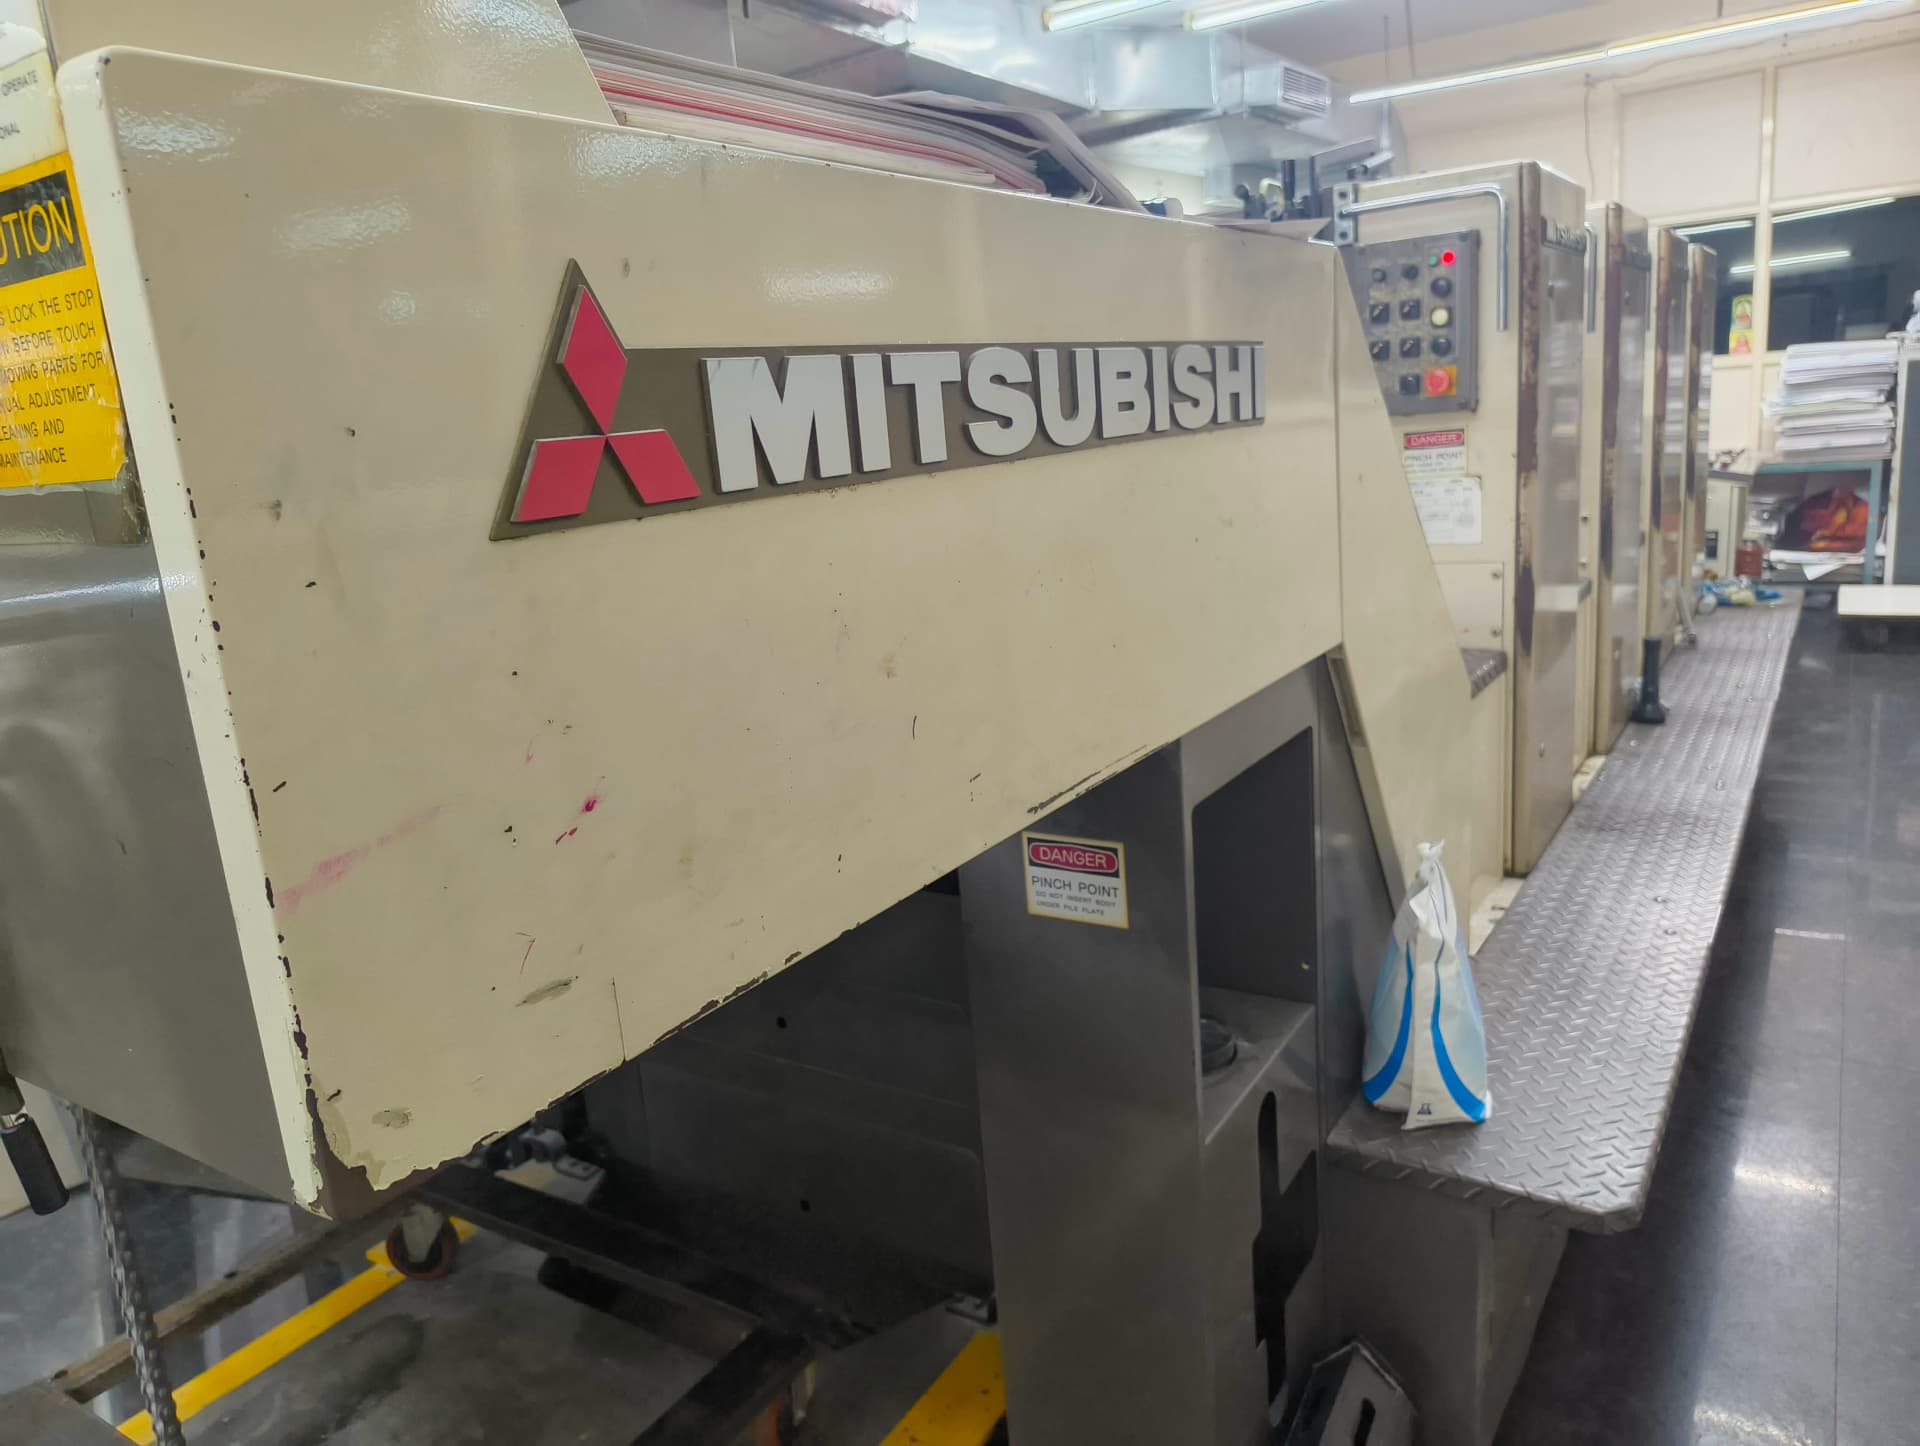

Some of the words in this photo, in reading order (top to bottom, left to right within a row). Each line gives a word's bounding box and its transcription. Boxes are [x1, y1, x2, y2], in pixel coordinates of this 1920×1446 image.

[8, 303, 37, 324] LOCK
[38, 296, 61, 316] THE
[64, 288, 94, 311] STOP
[12, 329, 54, 353] BEFORE
[56, 320, 96, 344] TOUCH
[41, 355, 77, 378] PARTS
[81, 350, 103, 370] FOR
[43, 418, 65, 436] AND
[704, 344, 1264, 493] MITSUBISHI
[1039, 847, 1107, 868] DANGER
[1031, 875, 1072, 892] PINCH
[1078, 882, 1120, 898] POINT
